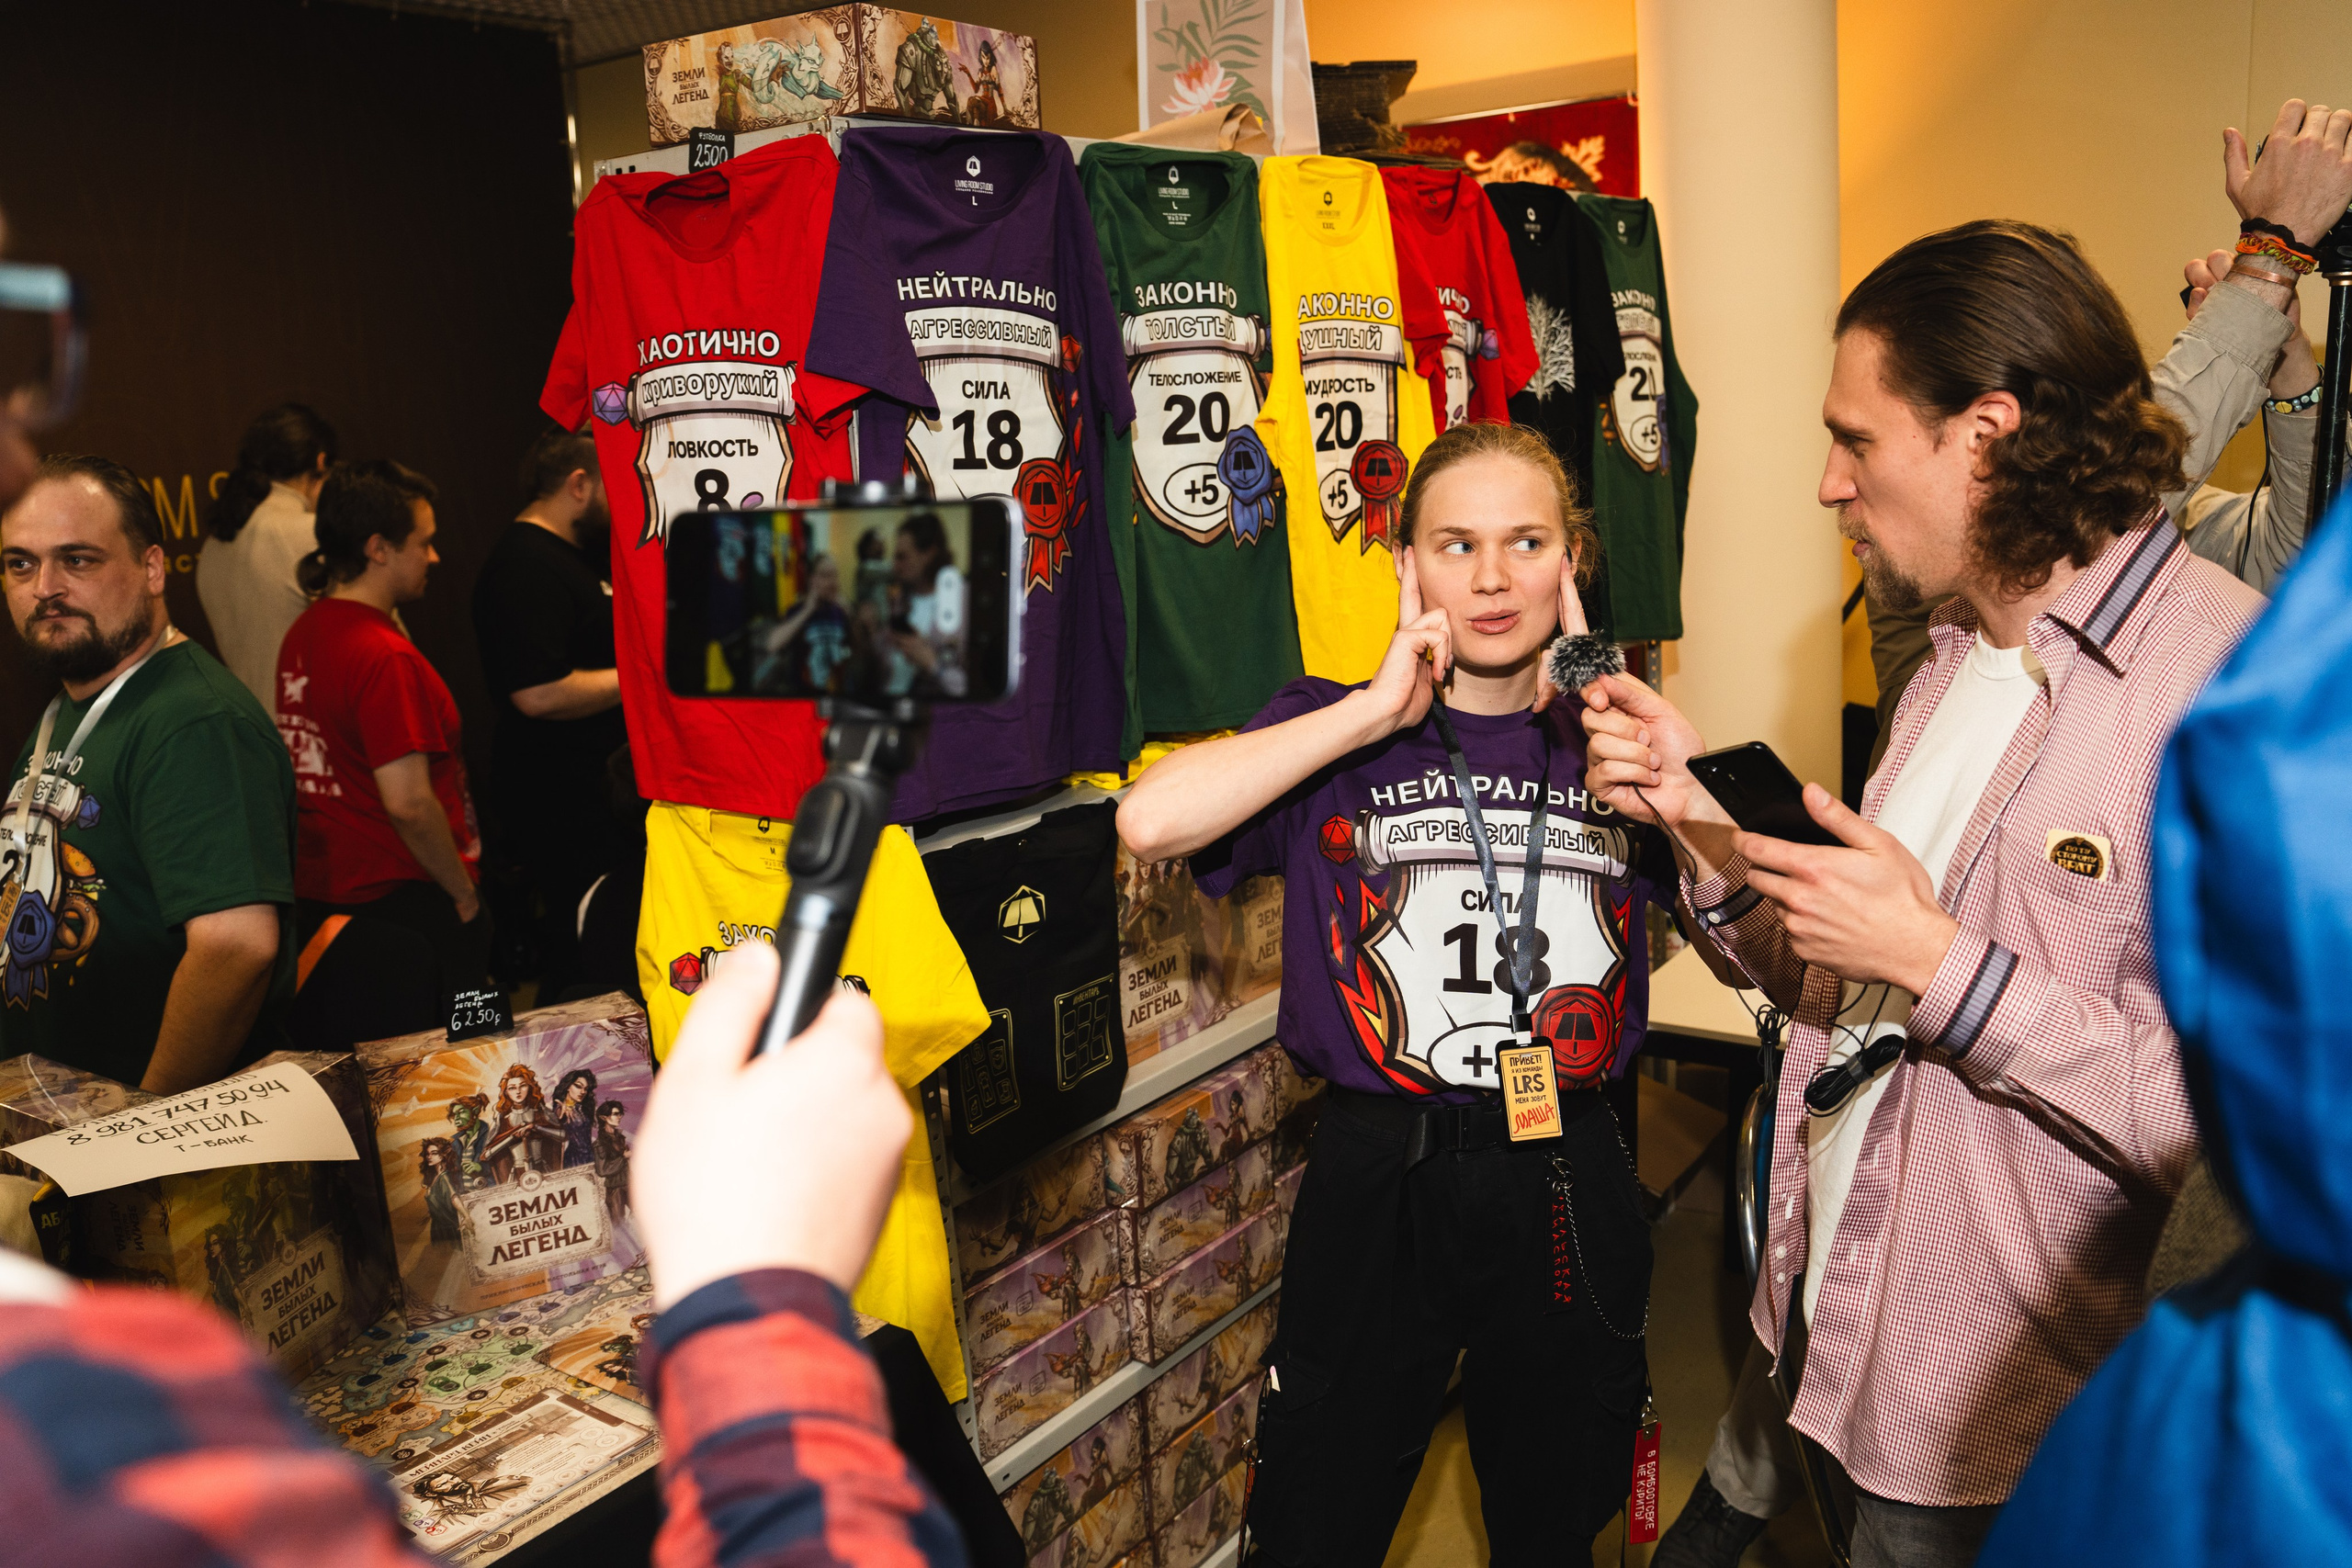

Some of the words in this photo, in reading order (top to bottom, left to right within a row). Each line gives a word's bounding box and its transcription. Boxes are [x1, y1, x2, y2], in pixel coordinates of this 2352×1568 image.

[672, 67, 707, 84] ЗЕМЛИ
[672, 89, 710, 106] ЛЕГЕНД
[693, 143, 729, 168] 2500
[972, 196, 978, 206] L
[1171, 201, 1179, 209] L
[897, 271, 1057, 312] НЕЙТРАЛЬНО
[1135, 280, 1238, 310] ЗАКОННО
[1297, 292, 1394, 320] АКОННО
[910, 318, 1053, 349] АГРЕССИВНЫЙ
[1146, 314, 1237, 342] ТОЛСТЫЙ
[637, 329, 781, 367] ХАОТИЧНО
[642, 369, 779, 407] криворукий
[962, 379, 1012, 400] СИЛА
[1148, 371, 1242, 387] ТЕЛОСЛОЖЕНИЕ
[1162, 391, 1231, 446] 20
[1315, 400, 1363, 452] 20
[668, 439, 759, 458] ЛОВКОСТЬ
[953, 410, 1023, 469] 18
[694, 468, 733, 512] 8
[1184, 474, 1220, 505] +5
[1328, 479, 1349, 510] +5
[1257, 905, 1283, 929] ЗЕМ
[718, 920, 777, 947] ЗАКО
[1128, 955, 1177, 991] ЗЕМЛИ
[1443, 923, 1552, 996] 18
[1139, 979, 1169, 1001] БЫЛЫХ
[1127, 989, 1183, 1029] ЛЕГЕНД
[1510, 1055, 1542, 1066] ПРИВЕТ!
[1513, 1073, 1545, 1095] LRS
[66, 1133, 92, 1146] 8
[96, 1116, 153, 1138] 981
[152, 1098, 210, 1119] 747
[218, 1089, 249, 1107] 50
[249, 1079, 291, 1099] 94
[136, 1111, 237, 1145] СЕРГЕЙ
[488, 1187, 580, 1226] ЗЕМЛИ
[510, 1213, 563, 1237] БЫЛЫХ
[488, 1224, 592, 1267] ЛЕГЕНД
[261, 1251, 326, 1312] ЗЕМЛИ
[277, 1283, 317, 1319] БЫЛЫХ
[980, 1301, 1009, 1325] ЗЕМЛИ
[266, 1291, 338, 1357] ЛЕГЕНД
[980, 1317, 1012, 1343] ЛЕГЕНД
[994, 1382, 1022, 1407] ЗЕМЛИ
[994, 1399, 1025, 1425] ЛЕГЕНД
[1636, 1464, 1646, 1478] НЕ
[1635, 1480, 1645, 1520] КУРИТЬ!
[1645, 1461, 1656, 1530] БОМБООТСЕКЕ
